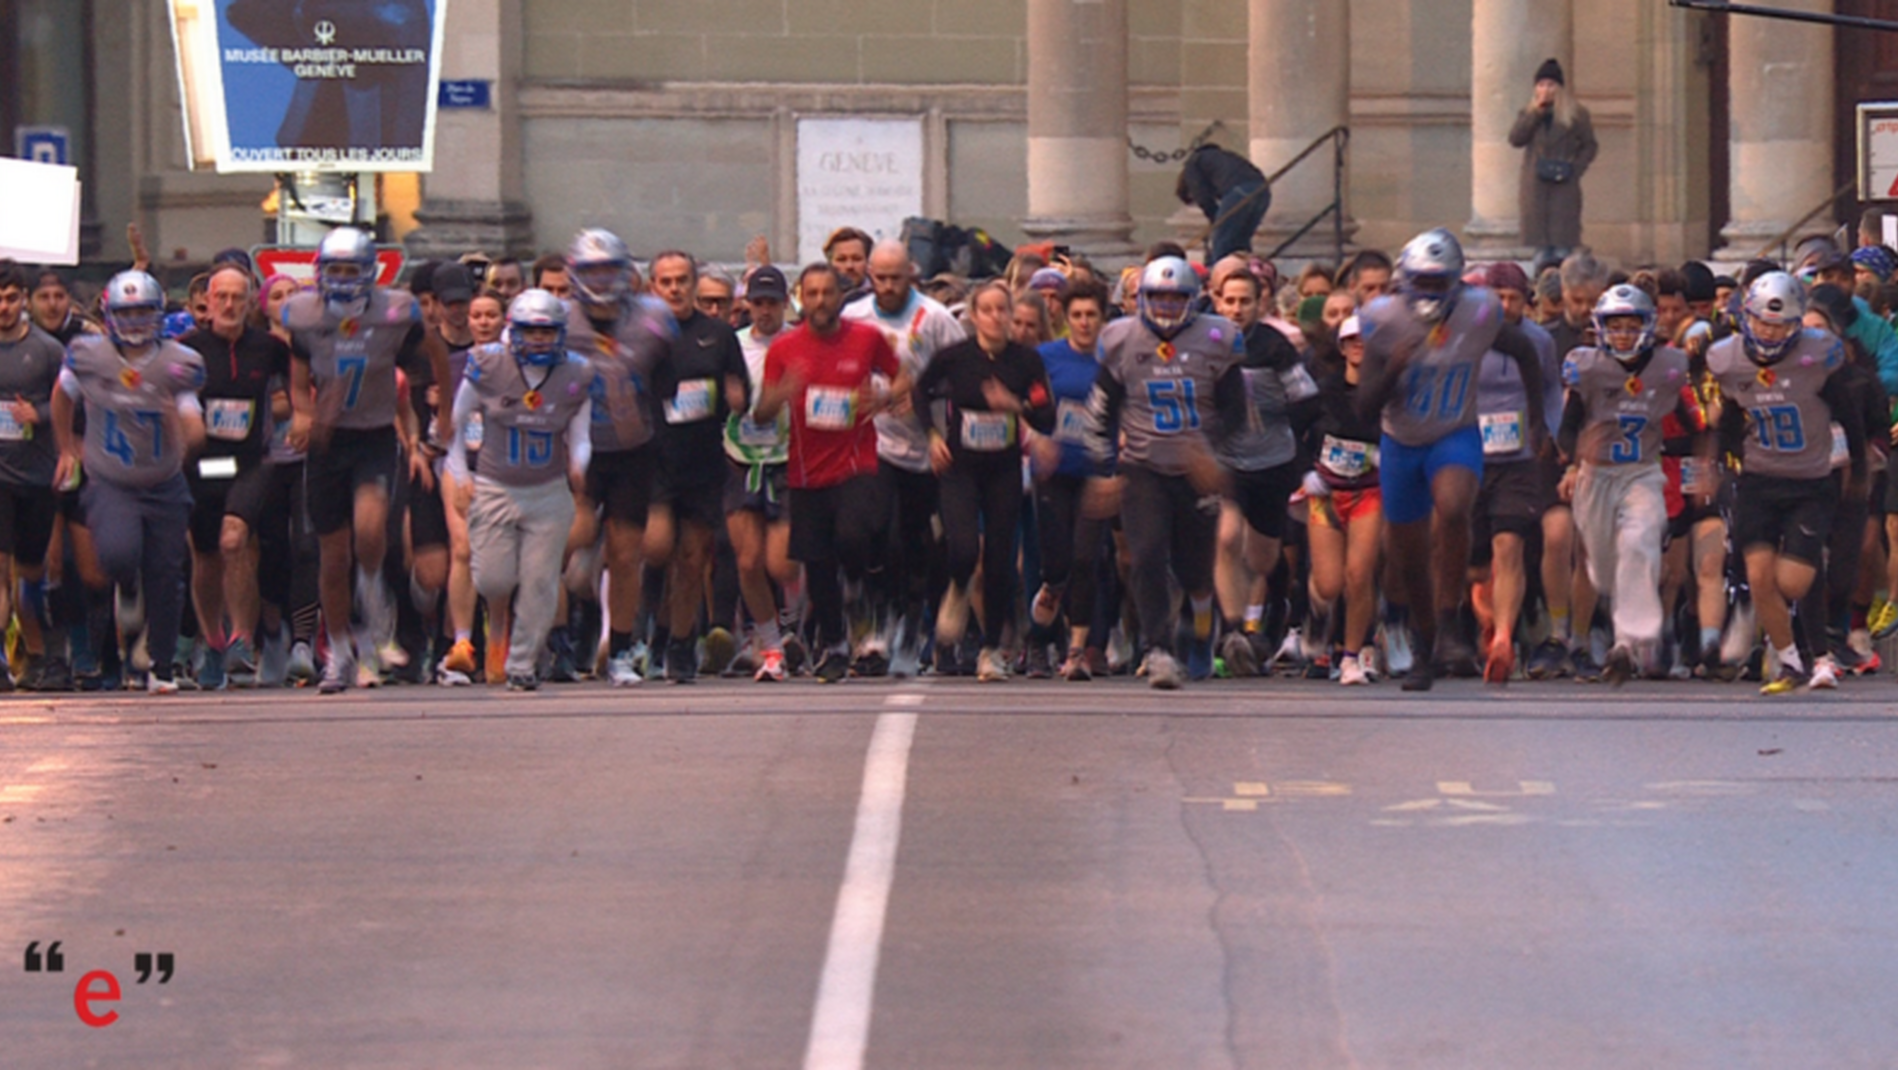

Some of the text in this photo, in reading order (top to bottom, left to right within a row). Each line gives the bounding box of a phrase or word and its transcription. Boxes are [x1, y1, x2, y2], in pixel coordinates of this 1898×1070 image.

[225, 45, 425, 63] MUSÉE BARBIER-MUELLER
[232, 147, 423, 162] OUVERT TOUS LES JOURS
[335, 354, 369, 411] 7
[1144, 377, 1200, 433] 51
[103, 409, 164, 468] 47
[507, 425, 554, 468] 15
[1610, 413, 1648, 463] 3
[1748, 402, 1806, 452] 19
